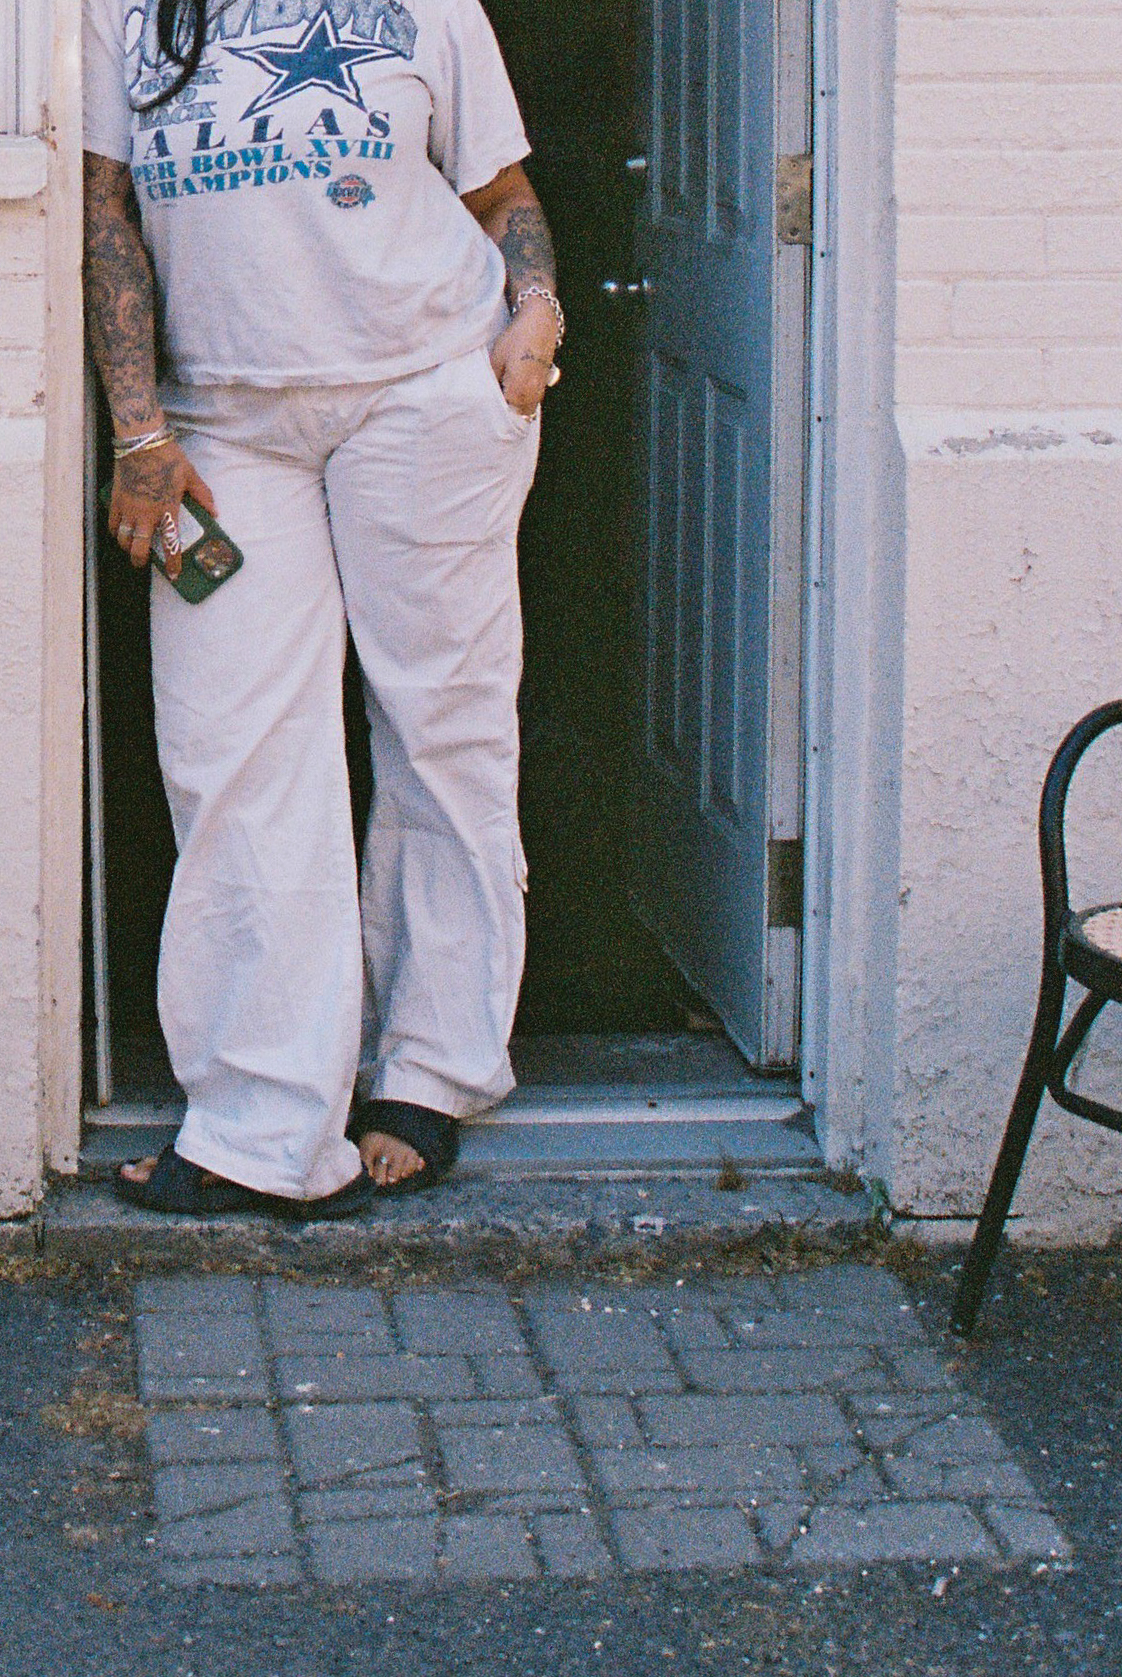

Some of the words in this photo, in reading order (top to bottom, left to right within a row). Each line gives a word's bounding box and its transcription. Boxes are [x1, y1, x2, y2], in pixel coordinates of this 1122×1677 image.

[129, 108, 391, 160] ALLAS
[131, 160, 178, 185] PER
[190, 143, 293, 176] BOWL
[146, 159, 332, 202] CHAMPIONS
